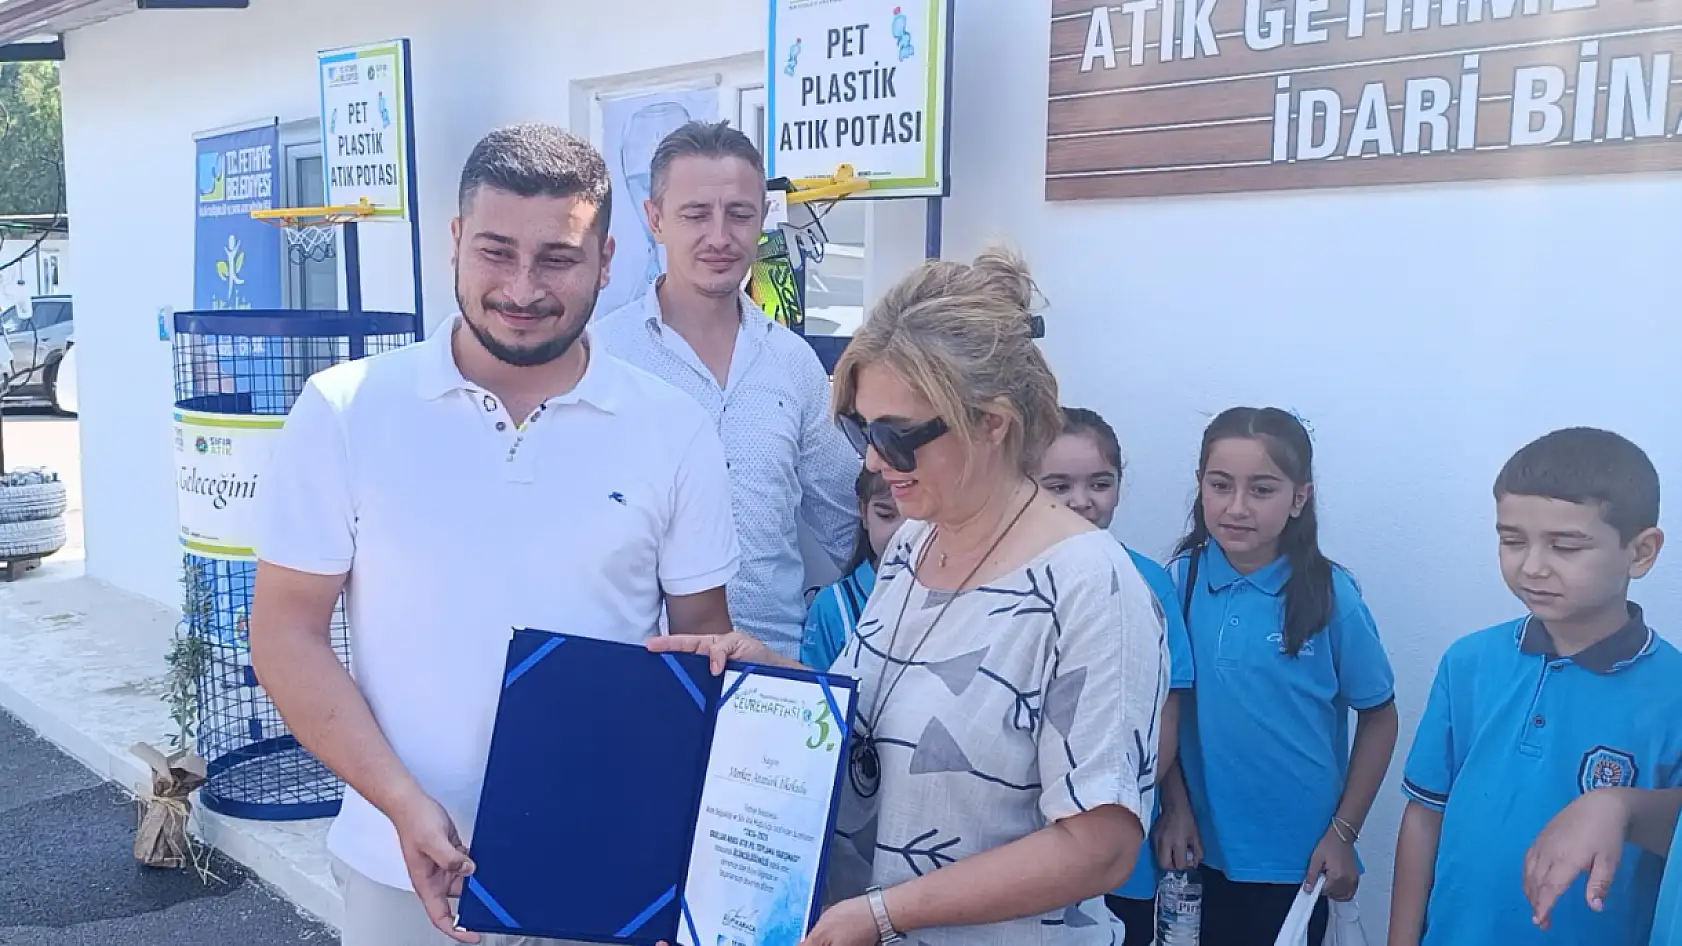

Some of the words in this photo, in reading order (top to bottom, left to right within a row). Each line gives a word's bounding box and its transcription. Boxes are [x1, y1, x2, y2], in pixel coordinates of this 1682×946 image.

[827, 24, 869, 59] PET
[1079, 0, 1220, 73] ATIK
[802, 61, 896, 106] PLASTİK
[1272, 53, 1480, 163] İDARİ
[1510, 39, 1682, 146] BİN
[348, 101, 368, 124] PET
[779, 119, 829, 151] ATIK
[836, 110, 921, 148] POTASI
[338, 128, 384, 156] PLASTİK
[331, 167, 355, 187] ATIK
[356, 164, 398, 186] POTASI
[181, 465, 258, 509] Geleceğini
